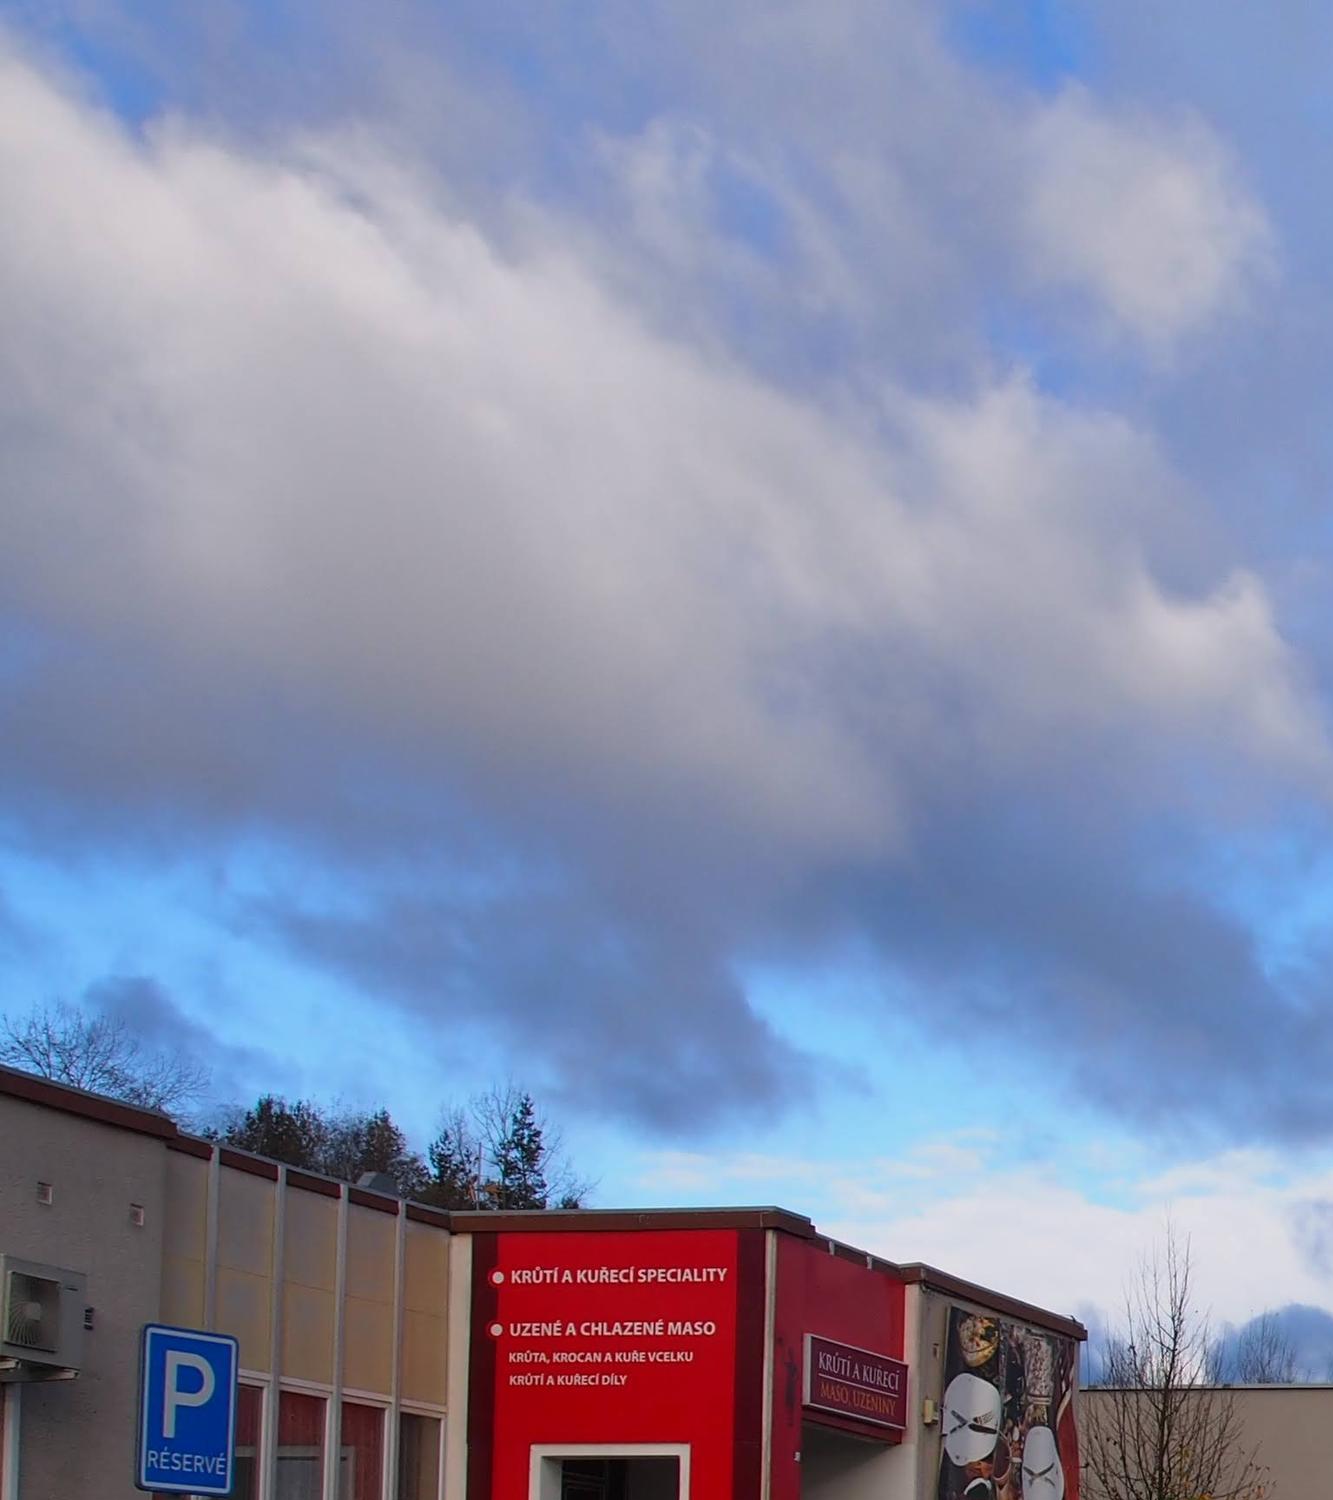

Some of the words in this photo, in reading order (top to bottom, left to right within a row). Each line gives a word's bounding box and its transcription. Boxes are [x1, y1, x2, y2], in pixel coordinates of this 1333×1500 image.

[511, 1266, 558, 1284] KRŮTÍ
[561, 1270, 573, 1284] A
[577, 1266, 635, 1283] KUŘECÍ
[638, 1268, 728, 1283] SPECIALITY
[509, 1320, 562, 1337] UZENÉ
[565, 1323, 576, 1336] A
[580, 1319, 664, 1336] CHLAZENÉ
[667, 1322, 716, 1335] MASO
[508, 1350, 550, 1364] KRŮTA,
[553, 1352, 601, 1363] KROCAN
[603, 1352, 613, 1363] A
[615, 1350, 646, 1362] KUŘE
[648, 1351, 693, 1362] VCELKU
[509, 1373, 544, 1386] KRŮTÍ
[546, 1375, 555, 1385] A
[557, 1373, 600, 1386] KUŘECÍ
[602, 1373, 628, 1385] DÍLY
[852, 1363, 860, 1380] A
[163, 1349, 216, 1439] P
[147, 1446, 227, 1475] RÉSERVÉ
